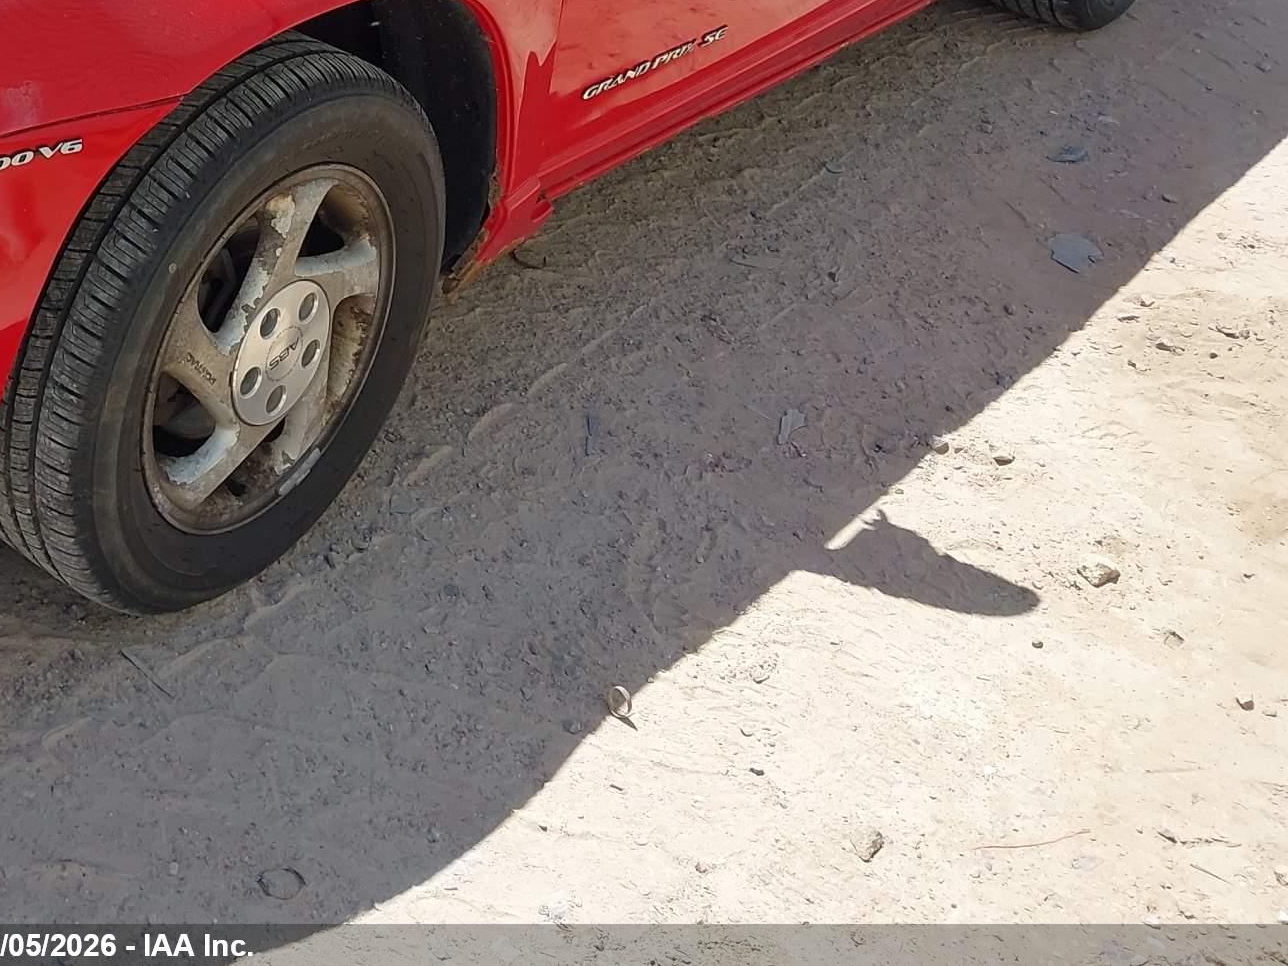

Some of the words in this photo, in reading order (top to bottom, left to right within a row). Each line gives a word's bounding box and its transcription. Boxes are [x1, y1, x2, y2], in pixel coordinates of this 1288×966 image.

[582, 60, 650, 101] GRAND
[650, 39, 697, 71] PRIX
[699, 24, 728, 48] SE
[37, 137, 83, 160] V6
[269, 337, 300, 371] ABS
